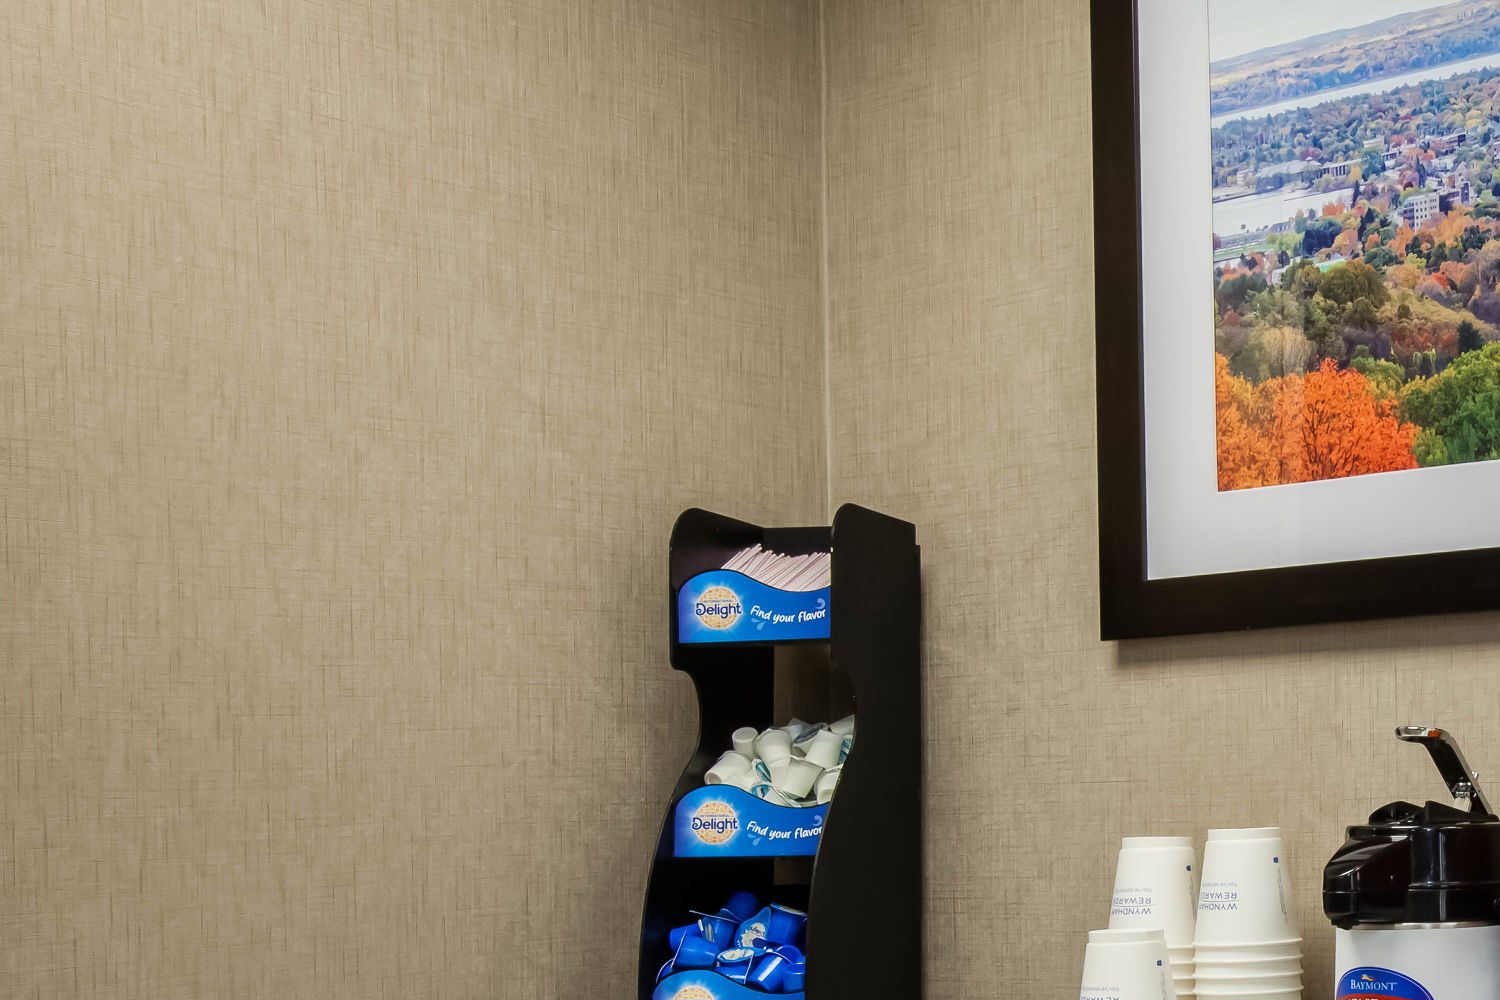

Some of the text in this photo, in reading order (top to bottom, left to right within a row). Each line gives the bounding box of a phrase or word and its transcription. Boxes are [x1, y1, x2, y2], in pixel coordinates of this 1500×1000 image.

[696, 602, 742, 619] Delight
[750, 605, 772, 620] Find
[772, 613, 795, 625] your
[692, 817, 738, 833] Delight
[747, 821, 769, 836] Find
[769, 829, 791, 841] your
[1350, 979, 1396, 991] BAYMONT
